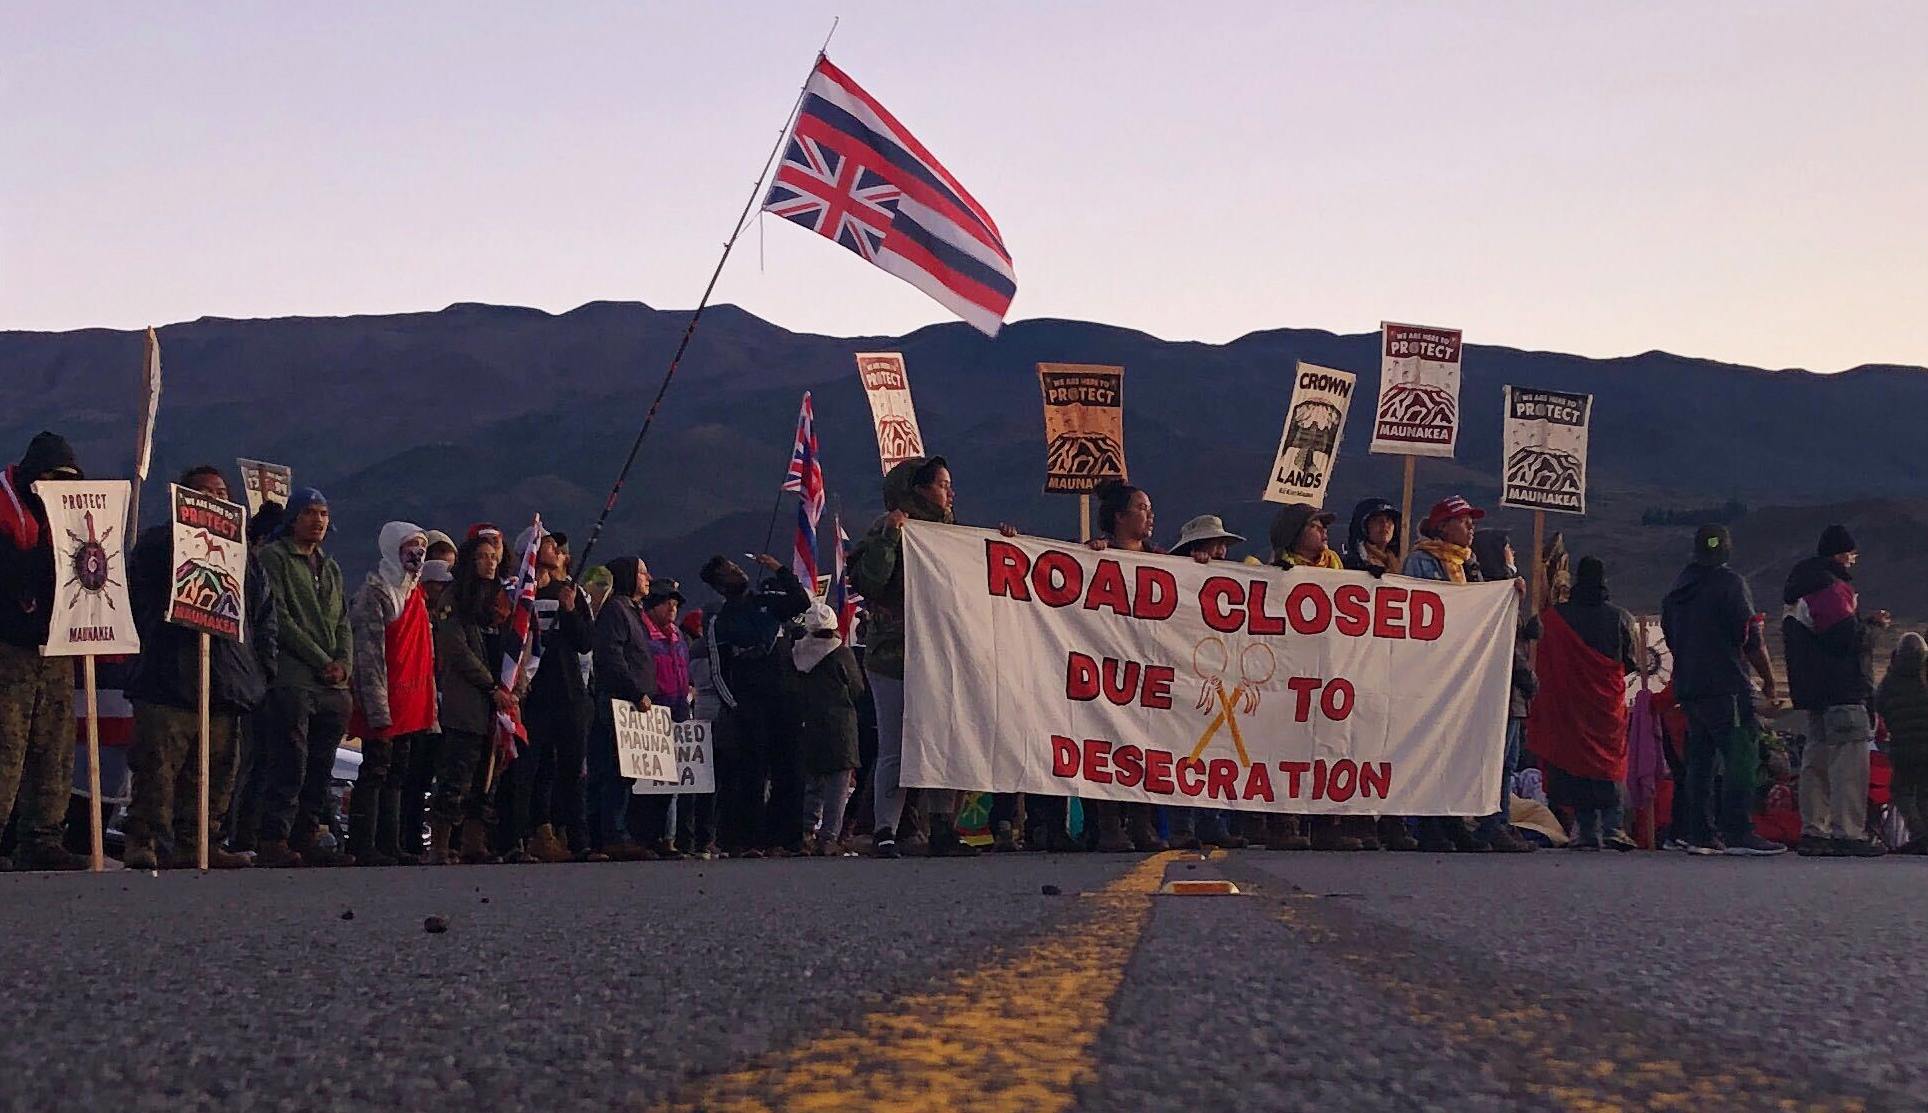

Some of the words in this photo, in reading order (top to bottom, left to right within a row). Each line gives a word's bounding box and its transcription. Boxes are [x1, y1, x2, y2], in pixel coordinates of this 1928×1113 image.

[1408, 332, 1422, 340] ARE
[1390, 341, 1455, 360] PROTECT
[1048, 386, 1115, 405] PROTECT
[1299, 372, 1352, 399] CROWN
[1516, 402, 1581, 423] PROTECT
[1379, 424, 1449, 440] MAUNAKEA
[1048, 477, 1101, 490] MAUNA
[1276, 466, 1323, 489] LANDS
[62, 493, 107, 510] PROTECT
[1508, 487, 1579, 507] MAUNAKEA
[181, 506, 238, 539] PROTECT
[985, 538, 1179, 620] ROAD
[1198, 576, 1446, 641] CLOSED
[69, 626, 115, 643] MAUNAKEA
[1066, 651, 1175, 710] DUE
[1287, 676, 1356, 723] TO
[618, 704, 672, 737] SACRED
[620, 730, 671, 755] MAUNA
[631, 753, 664, 777] KEA
[1051, 735, 1392, 802] DESECRATION
